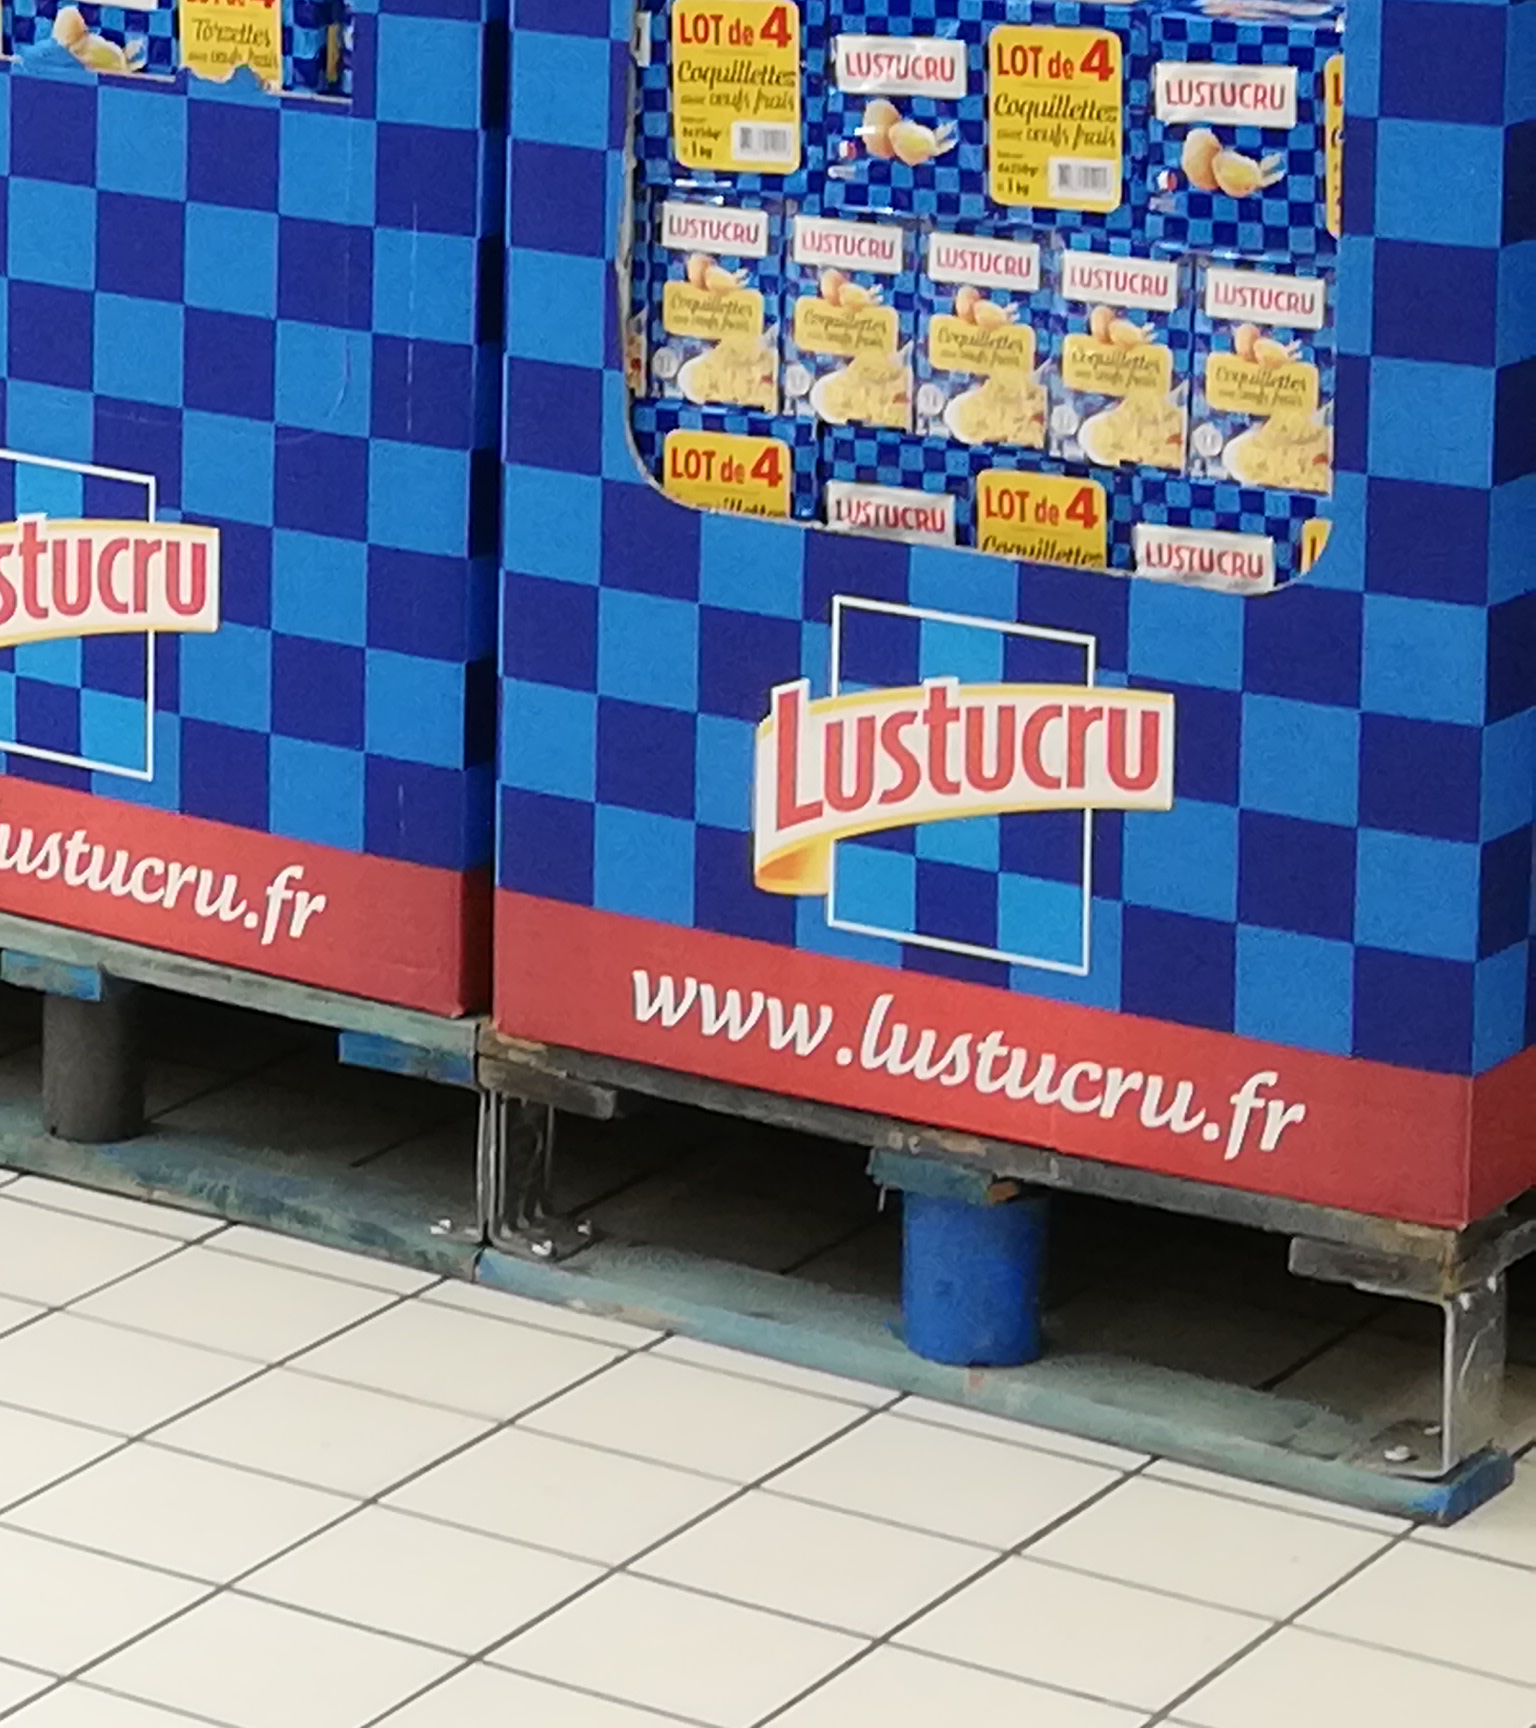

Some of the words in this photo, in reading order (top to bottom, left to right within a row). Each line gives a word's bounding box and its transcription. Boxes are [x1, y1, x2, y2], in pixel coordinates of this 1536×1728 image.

[679, 13, 725, 45] LOT
[728, 17, 755, 46] de
[760, 5, 793, 49] 4
[676, 59, 796, 92] Coquillettes
[844, 51, 956, 83] LUSTUCRU
[996, 44, 1043, 79] LOT
[1047, 49, 1075, 81] de
[1079, 38, 1115, 83] 4
[993, 92, 1118, 125] Coquillettes
[1165, 79, 1286, 111] LUSTUCRU
[667, 213, 761, 246] LUSTUCRU
[800, 229, 896, 261] LUSTUCRU
[936, 245, 1032, 279] LUSTUCRU
[1069, 264, 1169, 298] LUSTUCRU
[1213, 282, 1316, 316] LUSTUCRU
[670, 446, 716, 480] LOT
[719, 454, 746, 483] de
[749, 446, 784, 488] 4
[835, 497, 946, 535] LUSTUCRU
[983, 484, 1031, 523] LOT
[1034, 495, 1060, 527] de
[1064, 486, 1099, 529] 4
[1144, 540, 1266, 580] LUSTUCRU
[775, 684, 1162, 831] Lustucru
[631, 969, 1306, 1160] www.lustucru.fr
